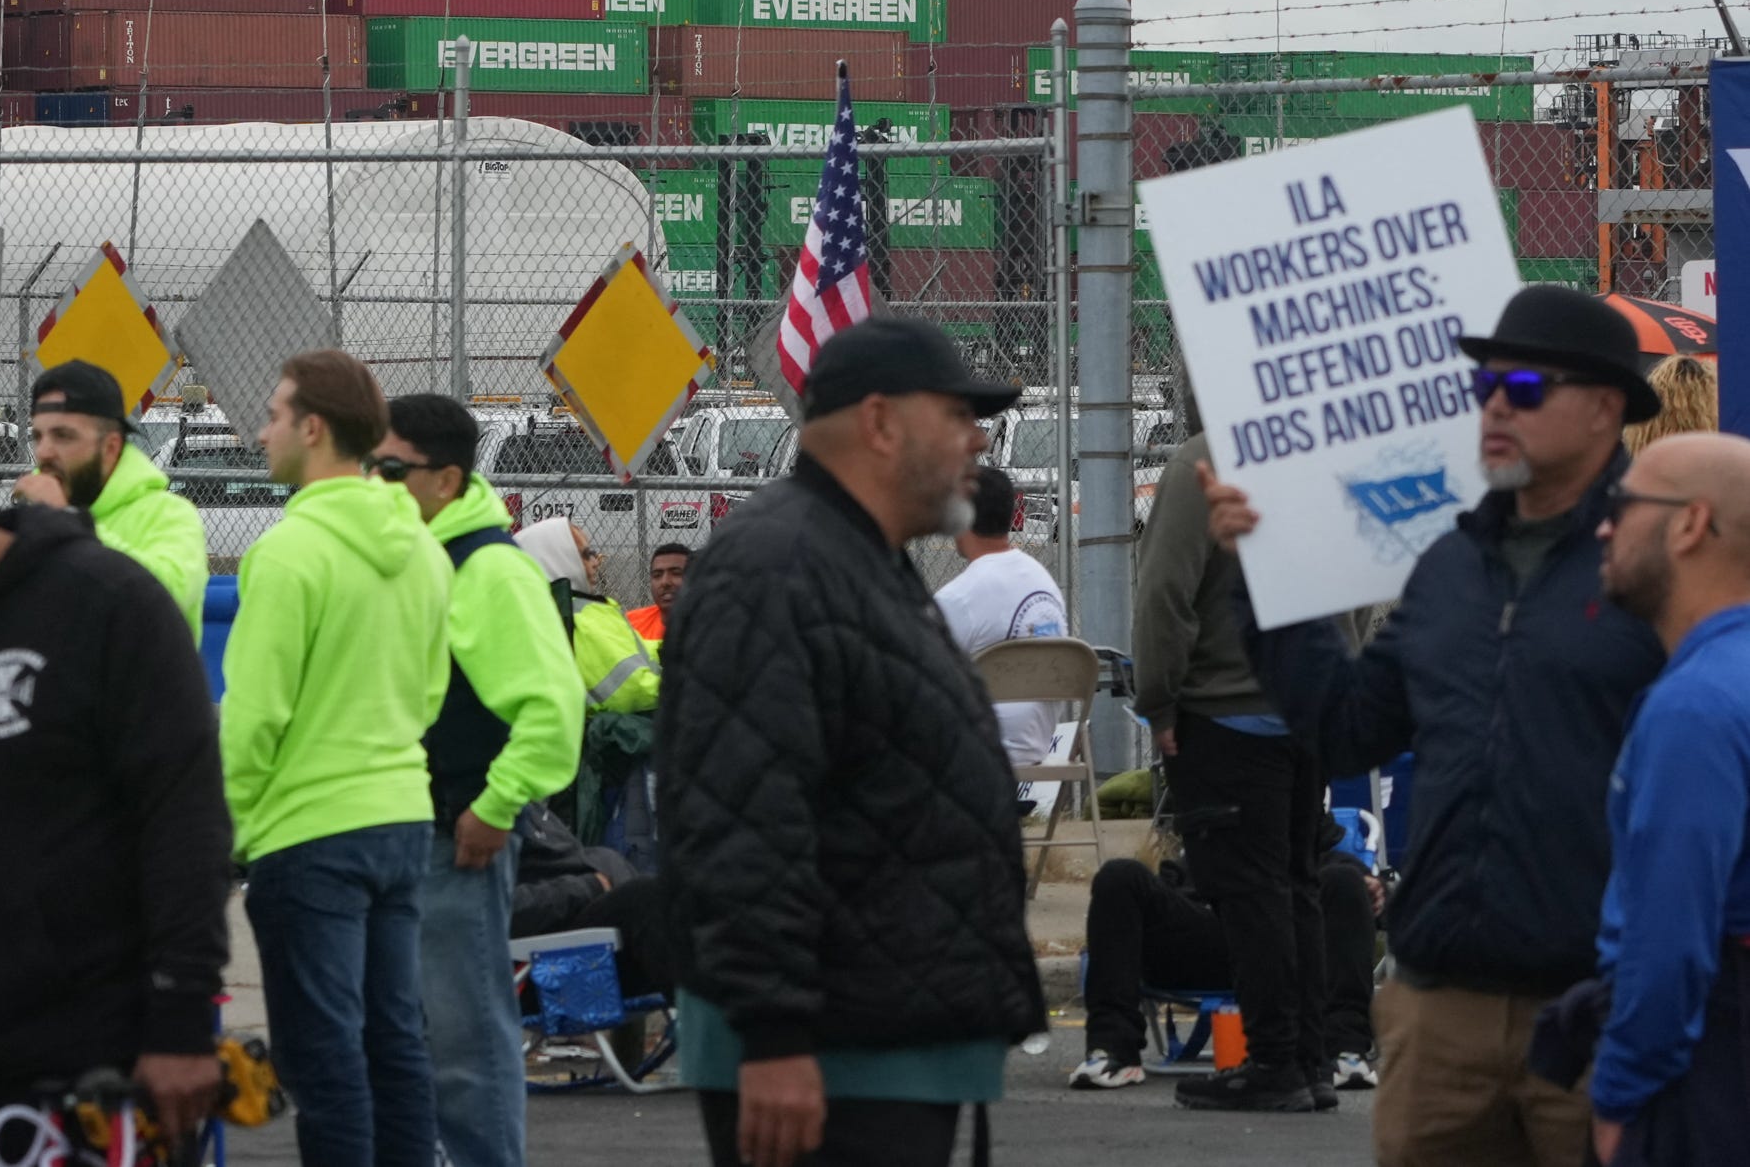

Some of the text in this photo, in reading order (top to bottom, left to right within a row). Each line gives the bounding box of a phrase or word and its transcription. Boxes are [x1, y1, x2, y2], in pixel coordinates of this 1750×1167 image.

[125, 20, 134, 65] TRITON
[1286, 175, 1346, 225] ILA
[1194, 201, 1469, 304] WORKERS OVER
[1249, 267, 1446, 349] MACHINES:
[1254, 315, 1465, 405] DEFEND OUR
[1231, 366, 1478, 469] JOBS AND RIGH
[665, 510, 698, 519] MAHER
